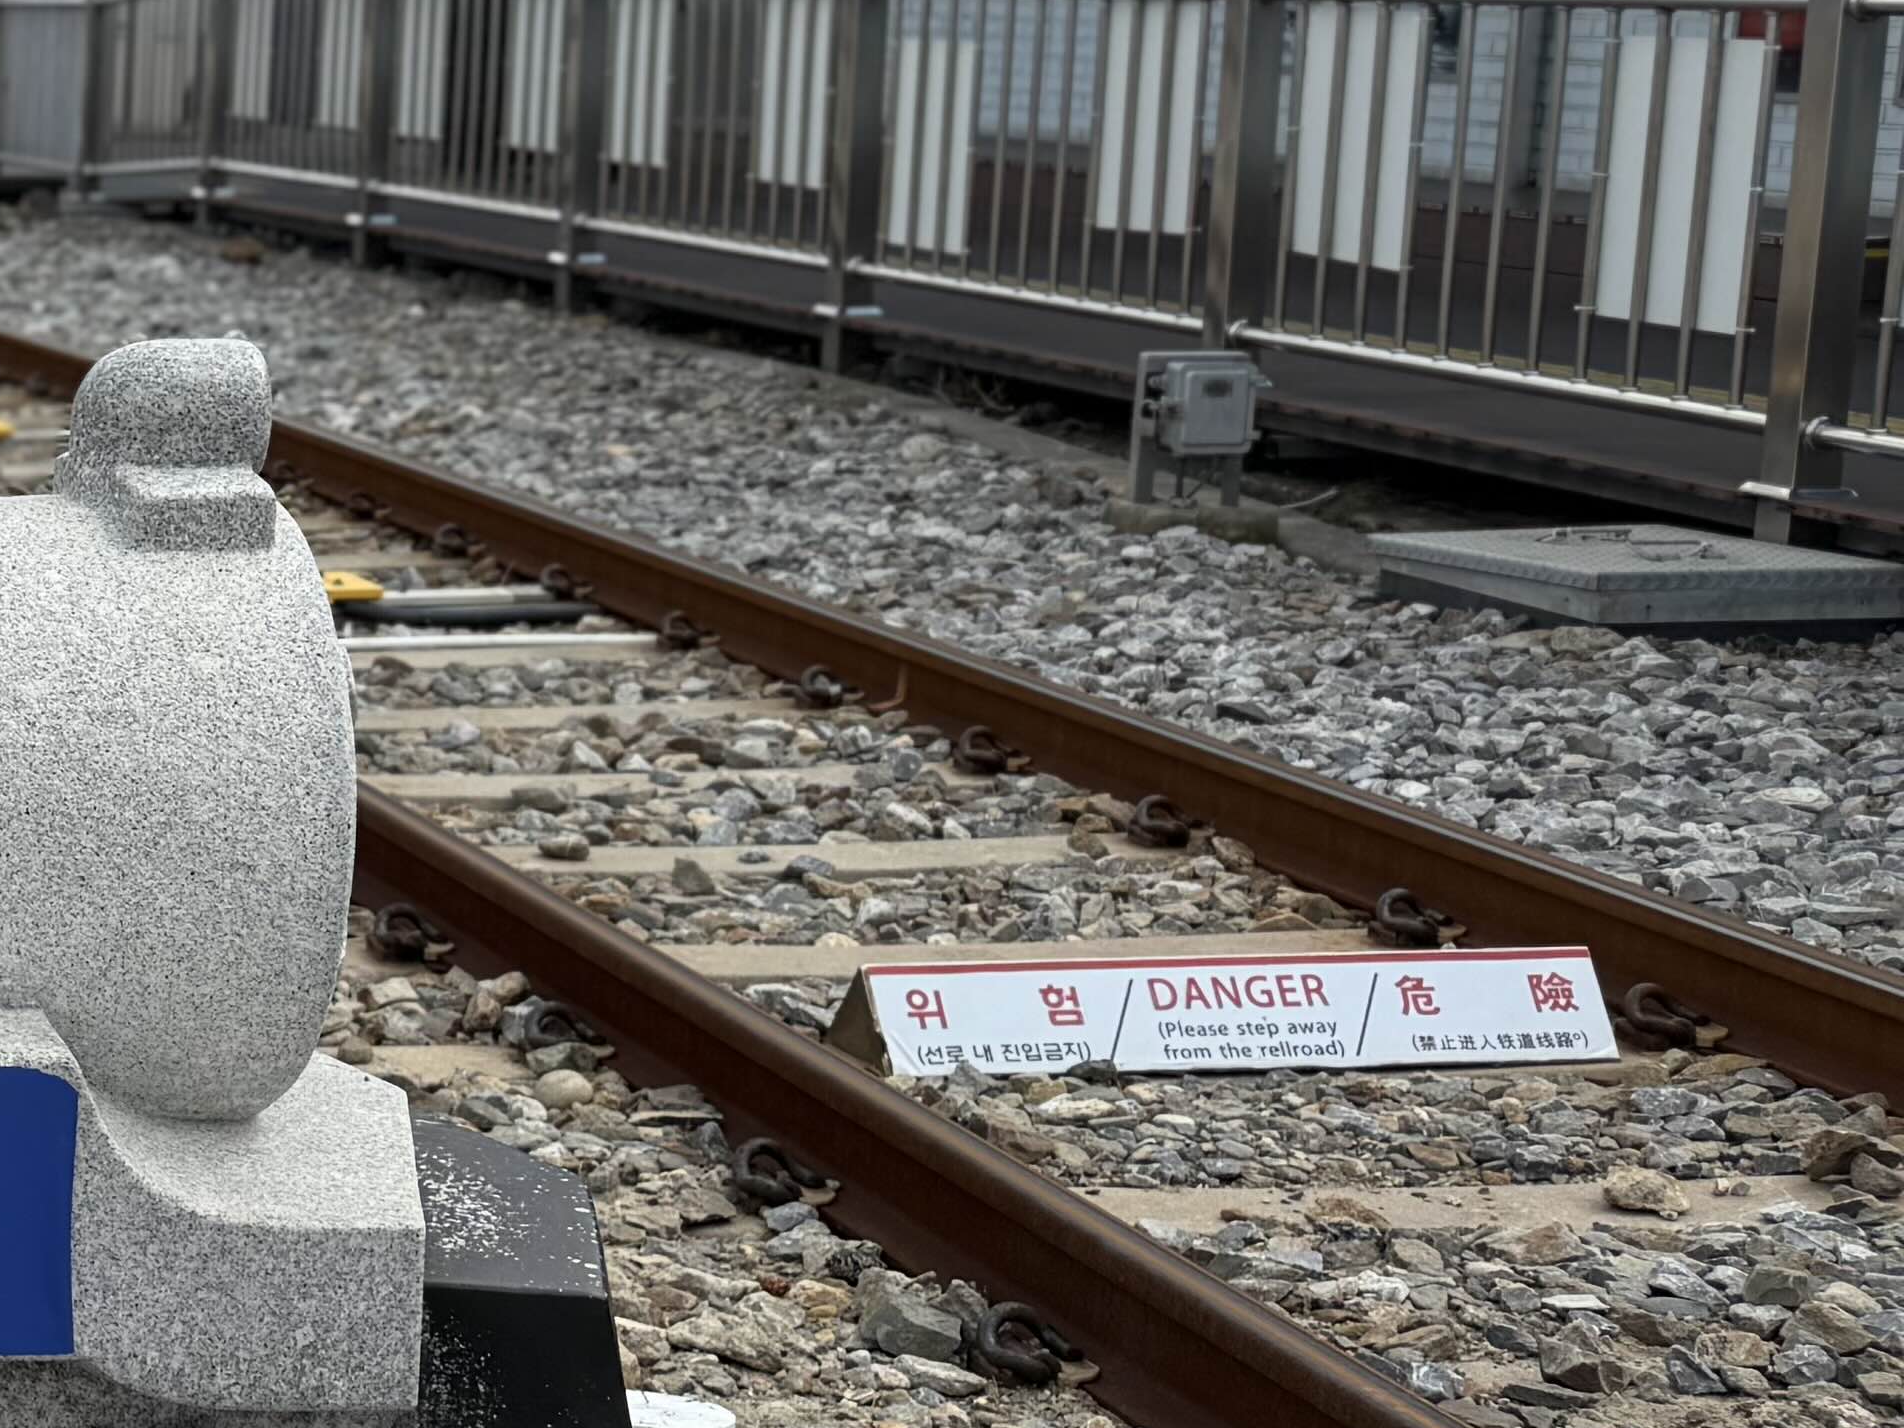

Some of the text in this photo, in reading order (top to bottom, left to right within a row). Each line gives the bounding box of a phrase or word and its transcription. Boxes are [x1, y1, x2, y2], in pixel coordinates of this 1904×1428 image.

[1147, 974, 1330, 1012] DANGER
[1158, 1020, 1337, 1040] (Please step away
[917, 1041, 1091, 1066] (선로 내 진입금지)
[1163, 1044, 1212, 1060] from
[1219, 1042, 1252, 1058] the
